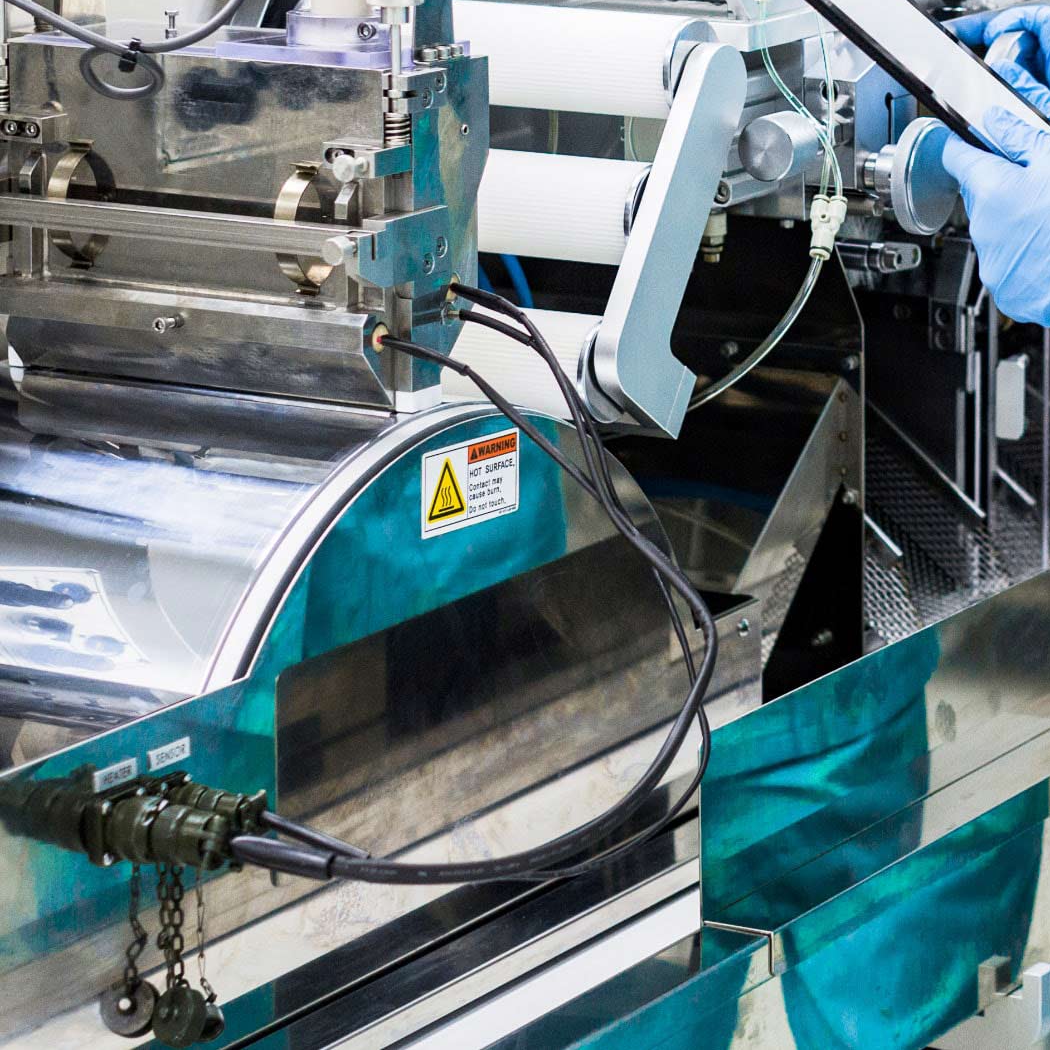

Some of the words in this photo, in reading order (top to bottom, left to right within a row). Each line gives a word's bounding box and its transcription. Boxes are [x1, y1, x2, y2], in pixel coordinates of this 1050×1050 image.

[478, 438, 516, 456] WARNING
[469, 466, 482, 479] HOT
[469, 479, 491, 492] Contact
[492, 477, 503, 485] may
[469, 491, 486, 501] cause
[469, 505, 477, 514] Do
[478, 501, 488, 511] not
